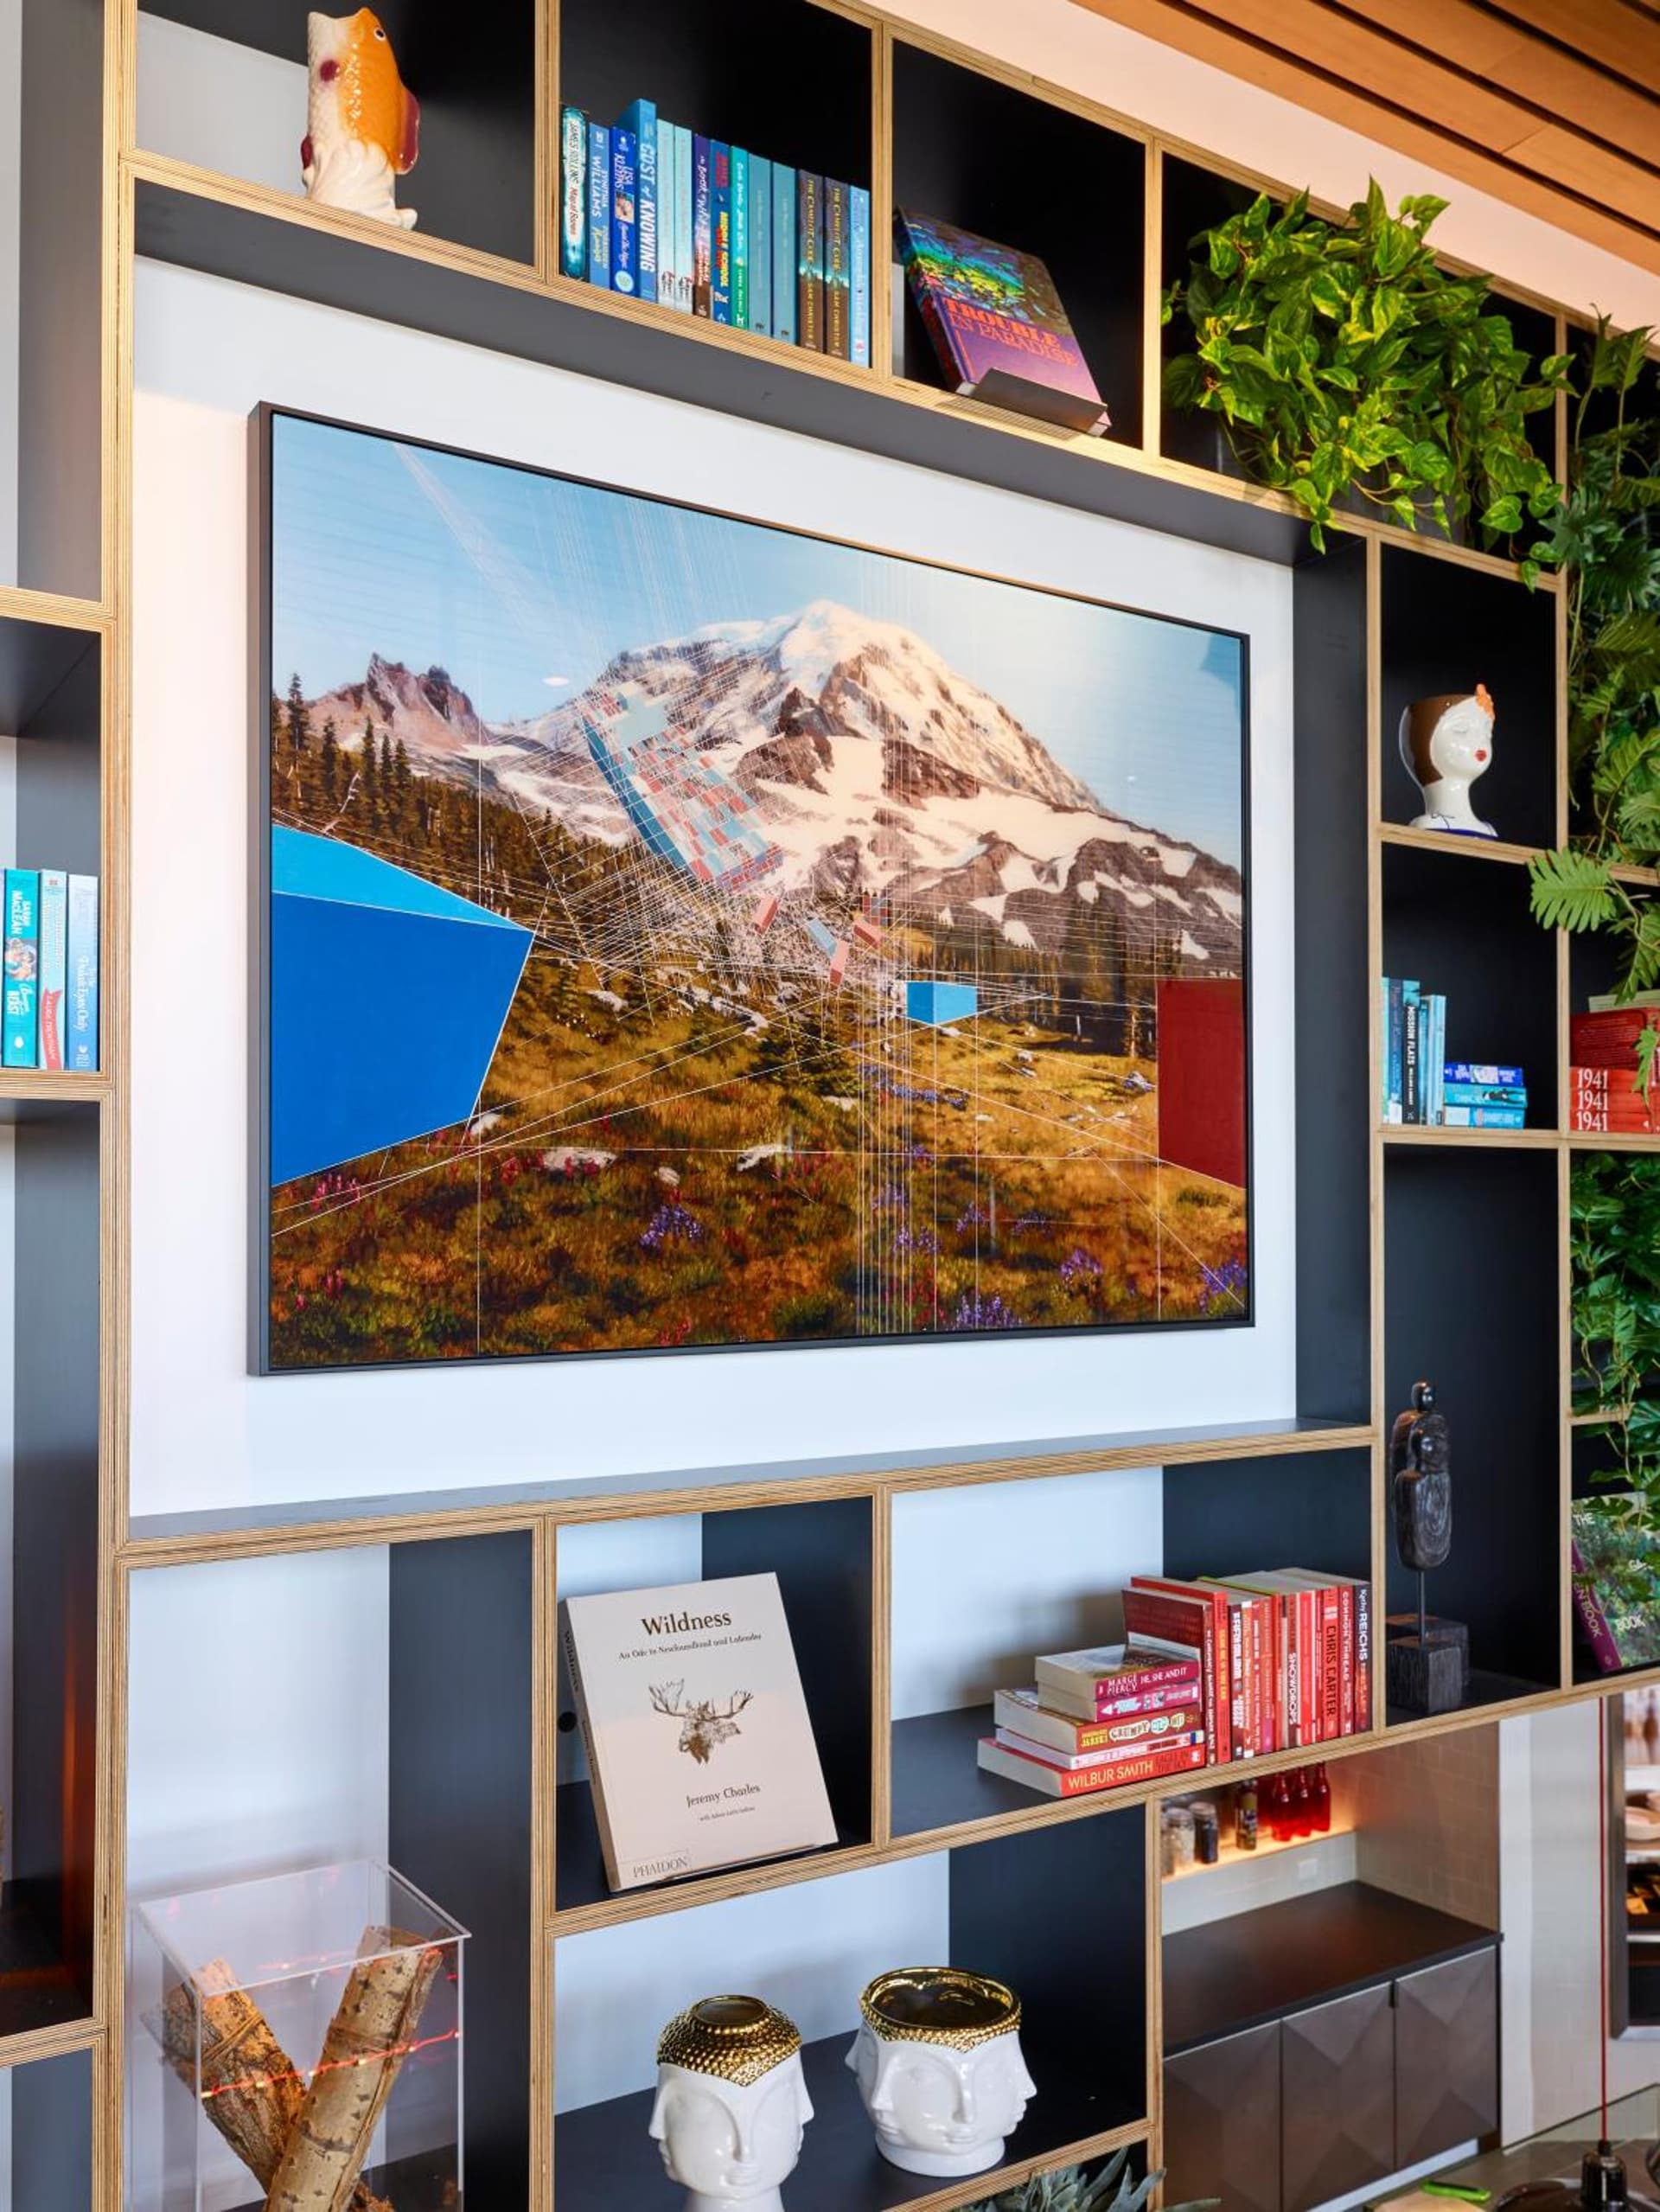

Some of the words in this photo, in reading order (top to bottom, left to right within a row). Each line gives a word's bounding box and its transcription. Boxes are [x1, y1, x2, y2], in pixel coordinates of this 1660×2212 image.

[622, 165, 633, 185] LISA
[640, 144, 655, 183] COST
[591, 156, 602, 217] WILLIAMS
[640, 199, 654, 272] KNOWING
[1407, 1006, 1415, 1039] MISSION
[1577, 1068, 1608, 1089] 1941
[1578, 1090, 1608, 1110] 1941
[1576, 1111, 1608, 1131] 1941
[1574, 1514, 1595, 1525] THE
[642, 1611, 732, 1636] Wildness
[1616, 1614, 1646, 1633] BOOK
[1326, 1625, 1337, 1665] CHRIS
[1359, 1612, 1369, 1661] REICHS
[1108, 1674, 1137, 1687] MARGE
[1164, 1670, 1180, 1679] AND
[1107, 1683, 1138, 1696] PIERCY
[1287, 1653, 1297, 1725] SNOWDROPS
[1325, 1666, 1337, 1717] CARTER
[1068, 1768, 1115, 1789] WILBUR
[1116, 1760, 1153, 1779] SMITH
[686, 1792, 721, 1808] Jeremy
[723, 1783, 761, 1800] Charles
[633, 1857, 689, 1878] PHAIDON
